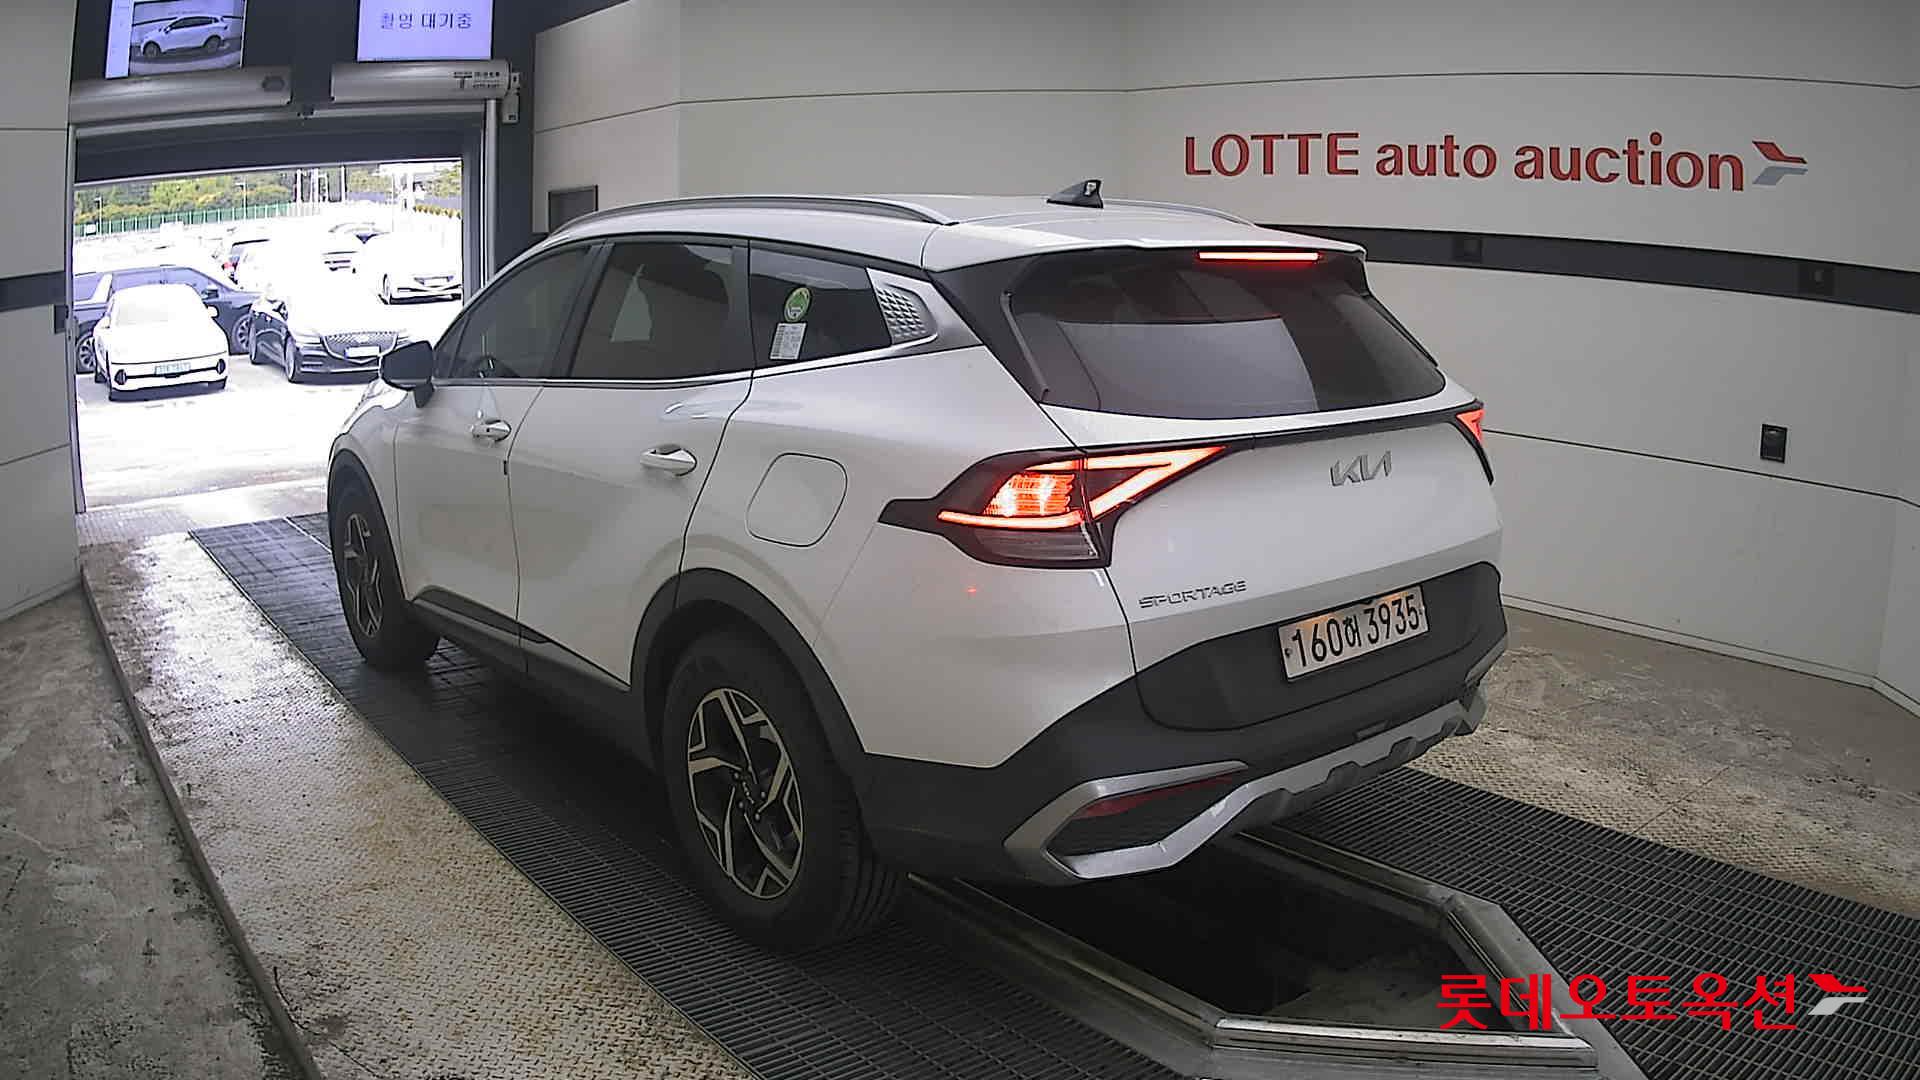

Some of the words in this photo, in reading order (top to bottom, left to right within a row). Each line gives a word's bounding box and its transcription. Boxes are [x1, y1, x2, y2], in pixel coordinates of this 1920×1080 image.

[421, 13, 471, 29] 대기중
[1185, 132, 1360, 177] LOTTE
[1375, 134, 1498, 178] auto
[1513, 132, 1744, 191] auction
[1330, 450, 1392, 487] KIA
[1138, 580, 1247, 609] SPORTAGE
[1291, 613, 1362, 667] 160허
[1363, 594, 1420, 644] 3935
